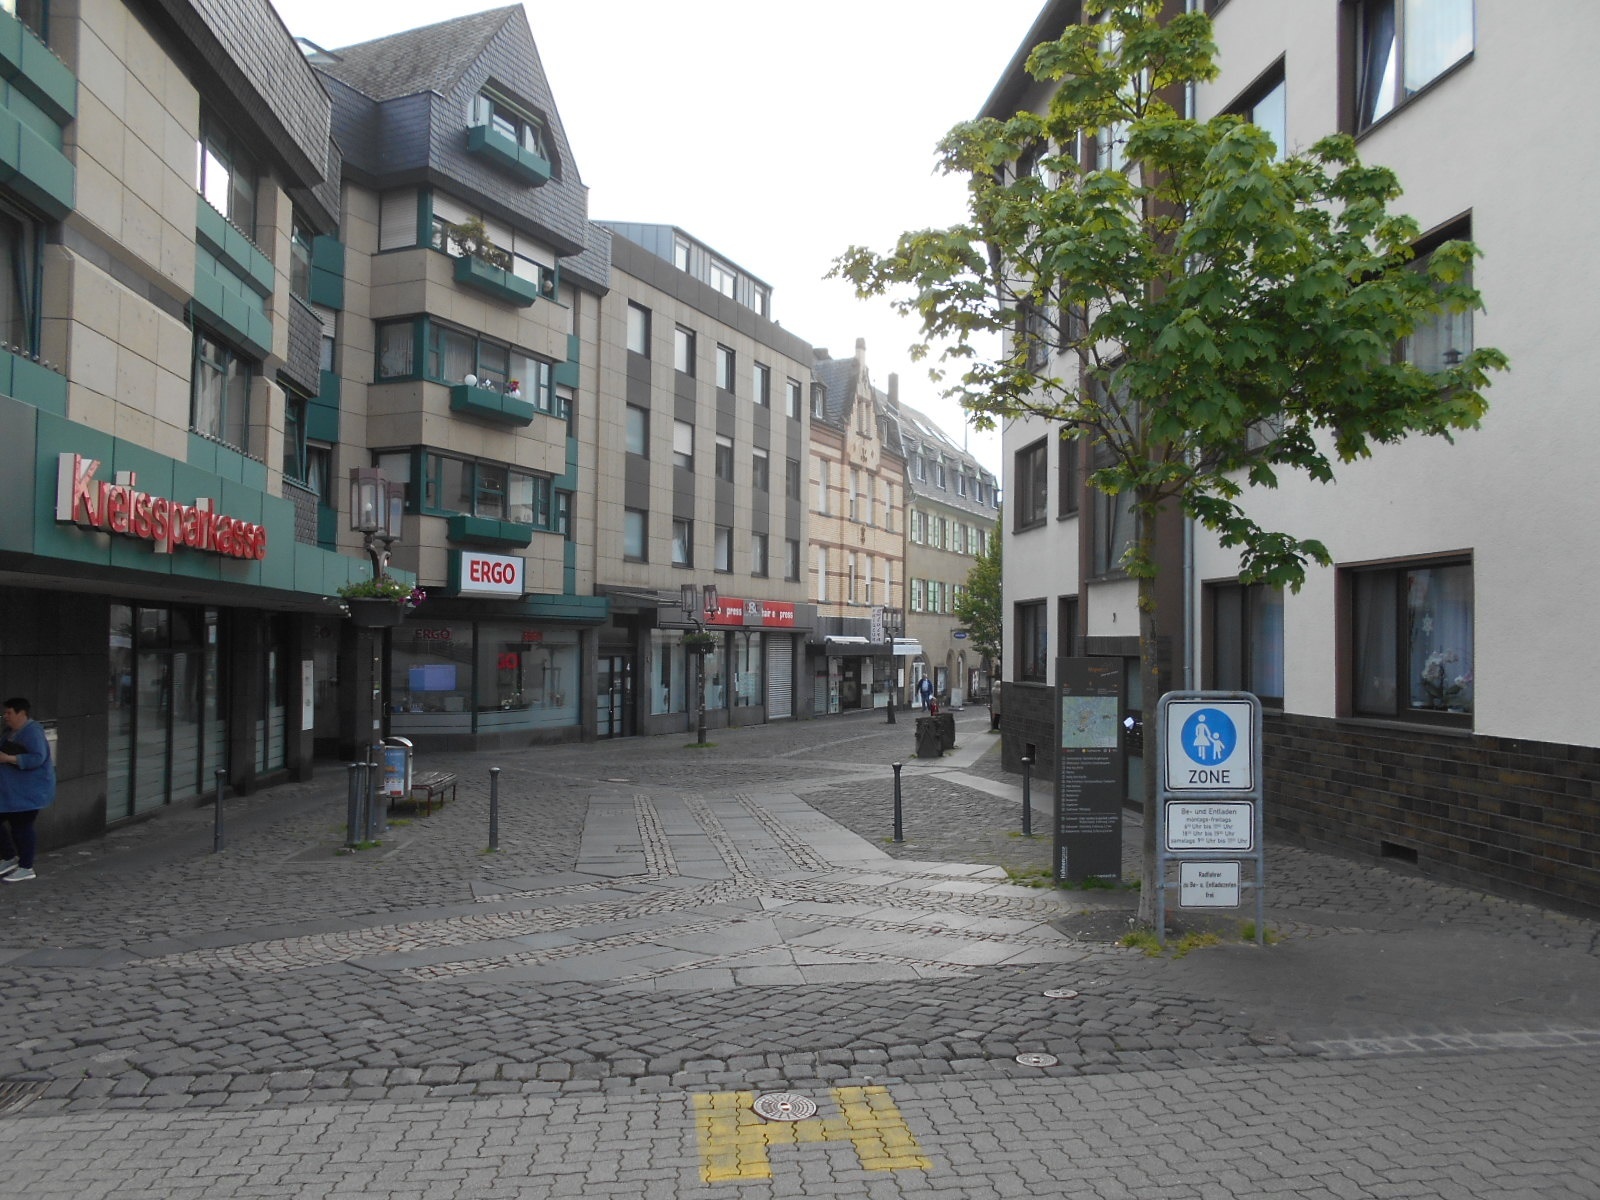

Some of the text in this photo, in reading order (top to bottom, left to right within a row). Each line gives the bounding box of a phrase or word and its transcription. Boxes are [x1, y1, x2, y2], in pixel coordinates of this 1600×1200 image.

[60, 453, 267, 560] Kreissparkasse
[469, 559, 516, 585] ERGO
[415, 628, 452, 641] ERGO
[1188, 769, 1231, 784] ZONE
[1181, 807, 1193, 815] Be-
[1208, 807, 1237, 815] Entladen
